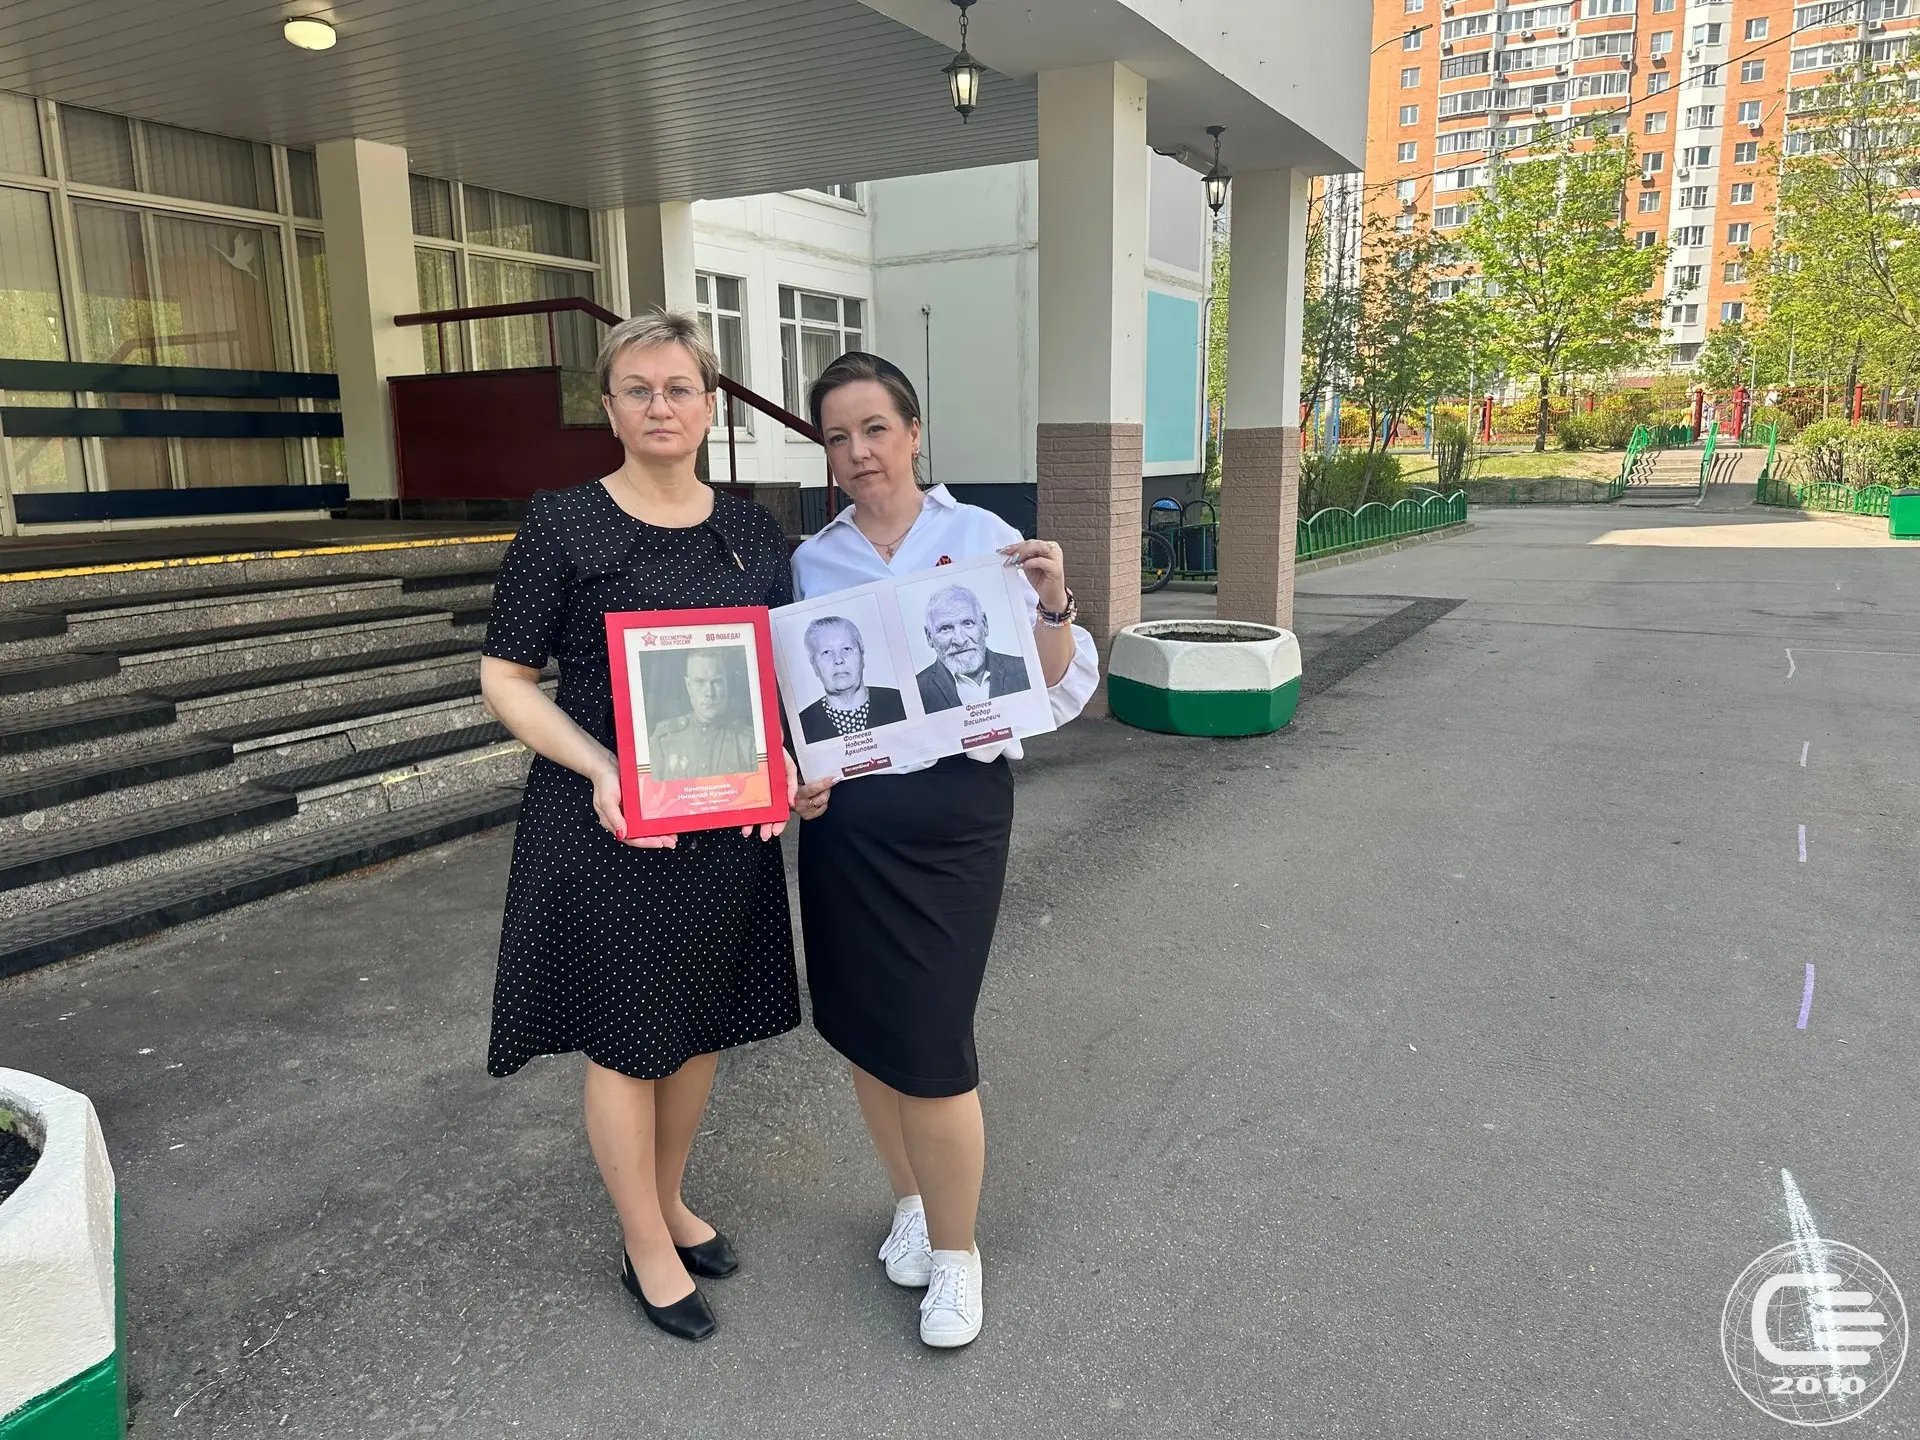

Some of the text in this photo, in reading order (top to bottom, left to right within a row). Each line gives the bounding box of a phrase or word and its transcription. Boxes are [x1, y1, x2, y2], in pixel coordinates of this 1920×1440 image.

[965, 701, 992, 712] Фатеев
[963, 713, 1001, 727] Васильевич
[843, 731, 872, 742] Фатеева
[845, 737, 873, 749] Надежда
[844, 743, 878, 756] Архиповна
[677, 791, 709, 800] Николай
